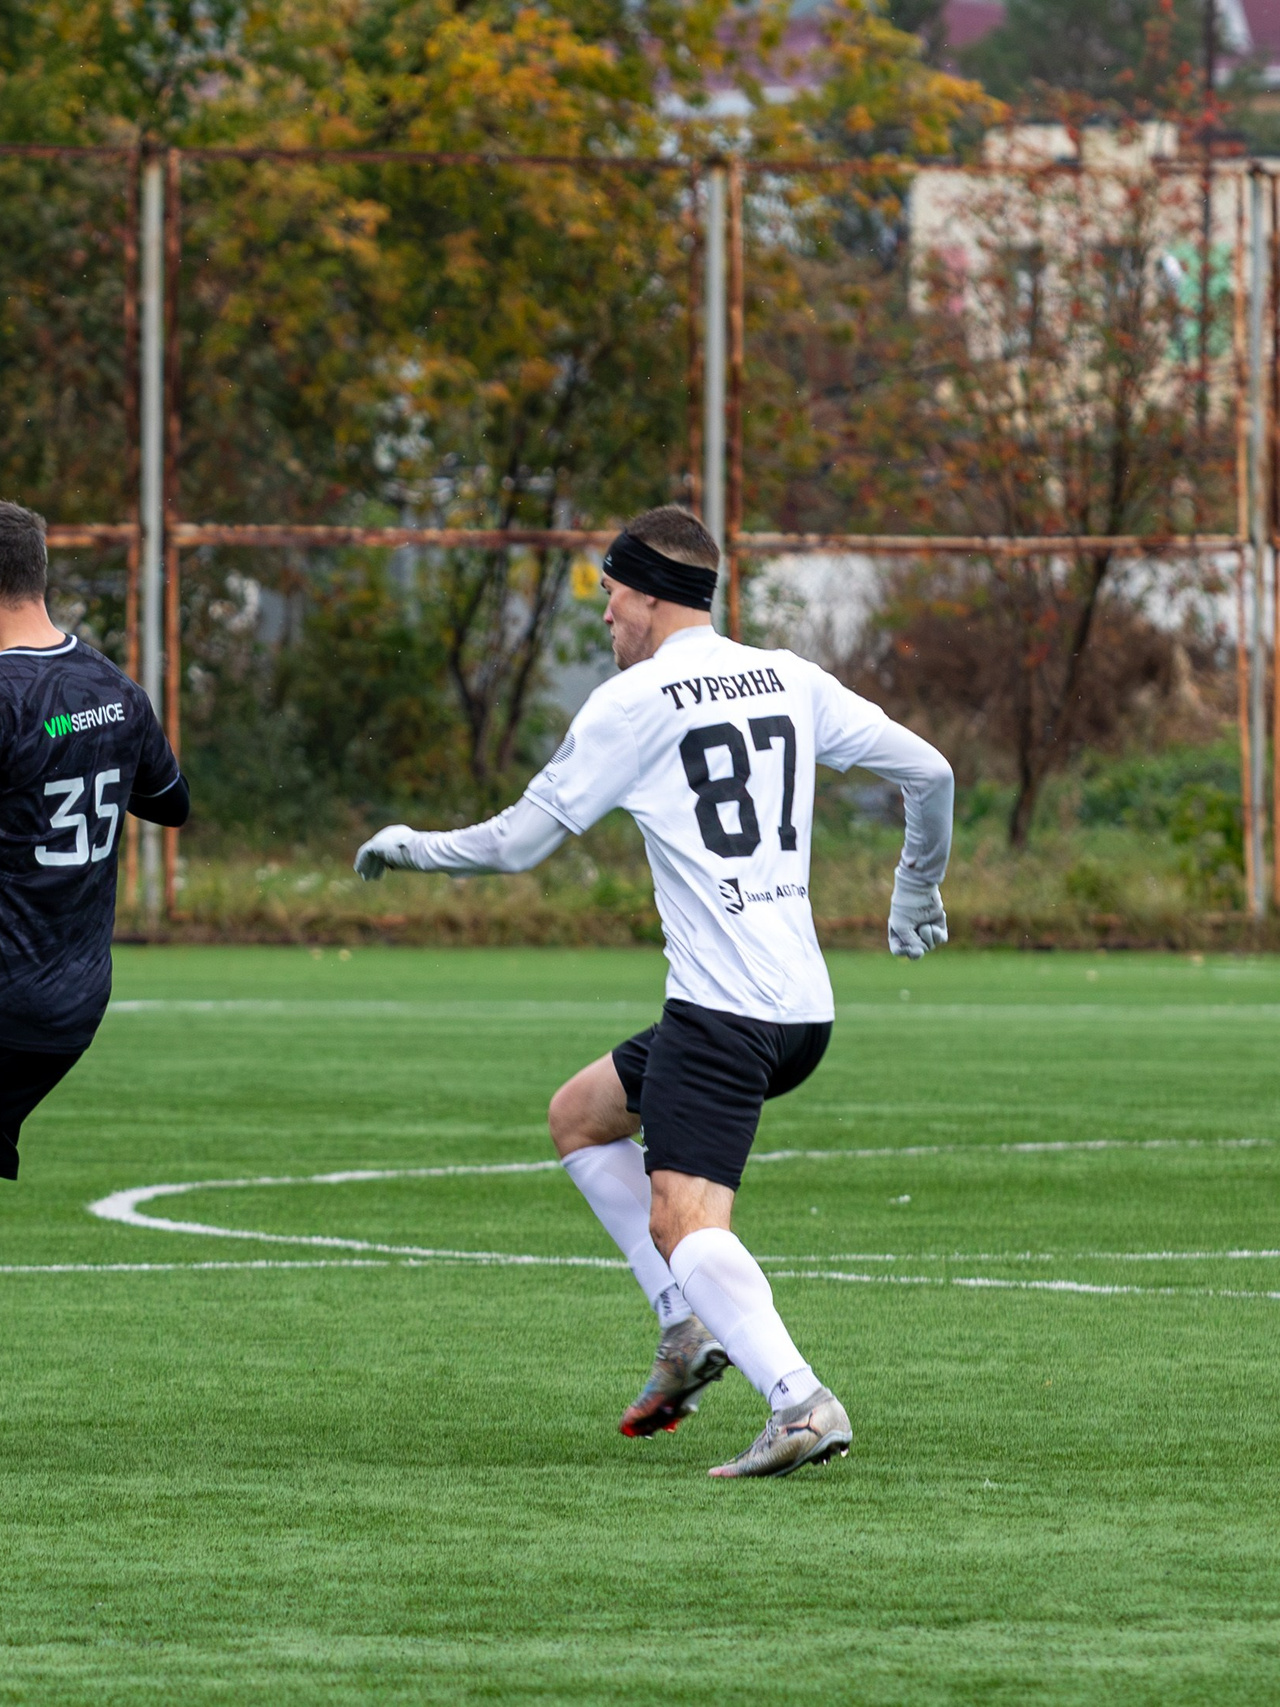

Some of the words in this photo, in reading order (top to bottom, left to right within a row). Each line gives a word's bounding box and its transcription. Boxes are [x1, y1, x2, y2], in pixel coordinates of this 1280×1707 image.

[44, 702, 125, 739] VINSERVICE
[661, 668, 786, 710] ТУРБИНА
[34, 768, 121, 866] 35
[679, 715, 797, 858] 87
